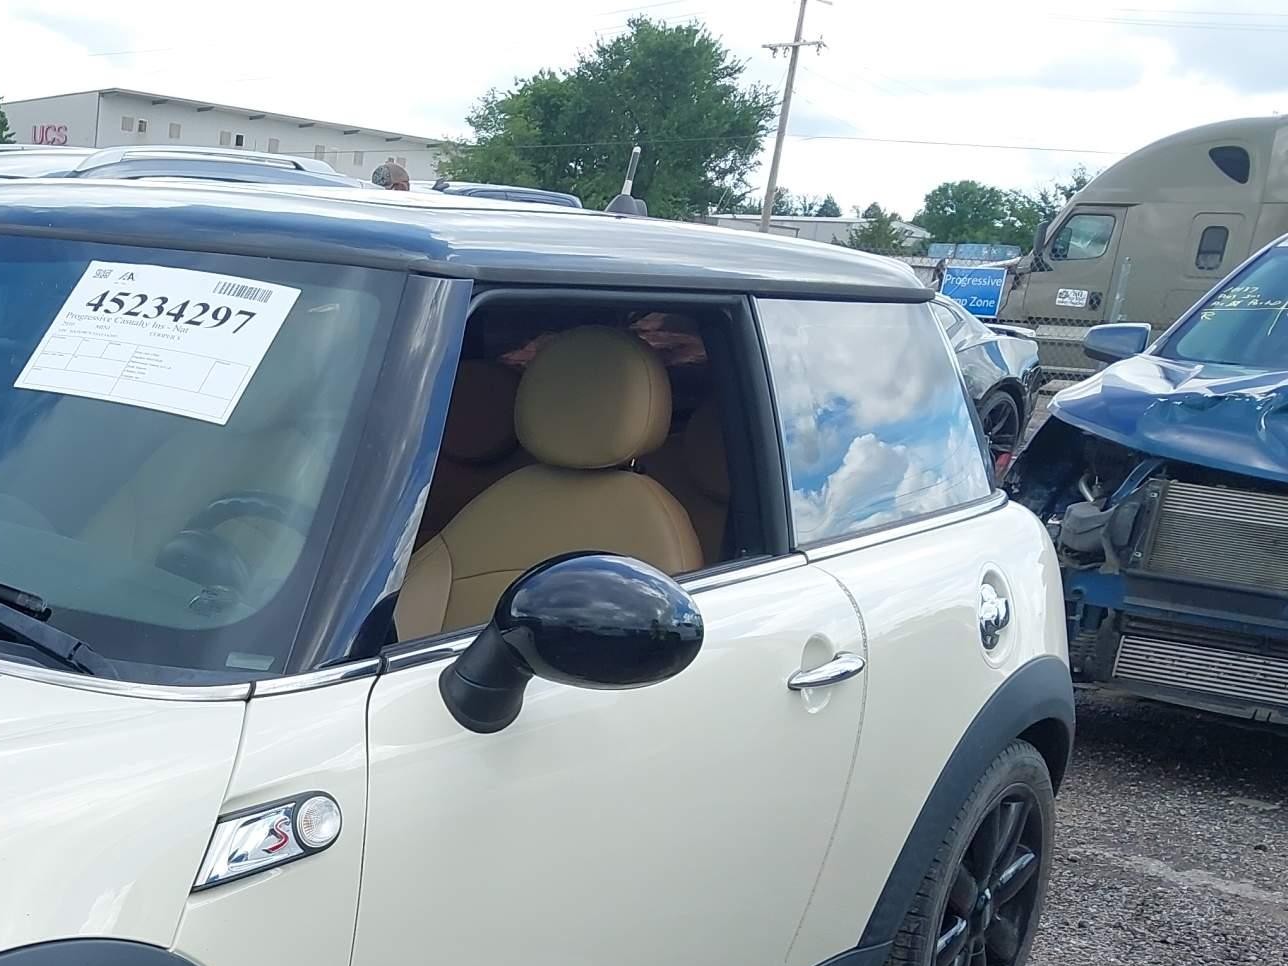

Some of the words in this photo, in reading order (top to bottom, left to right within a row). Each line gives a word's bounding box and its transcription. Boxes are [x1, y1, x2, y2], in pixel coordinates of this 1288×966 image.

[32, 125, 68, 145] UCS
[945, 274, 1002, 287] Progressive
[85, 290, 257, 334] 45234297
[969, 296, 996, 308] Zone
[66, 311, 113, 323] Progressive
[114, 316, 149, 329] Casualty
[152, 320, 165, 331] Ins
[171, 324, 189, 334] Nat
[262, 816, 291, 853] S
